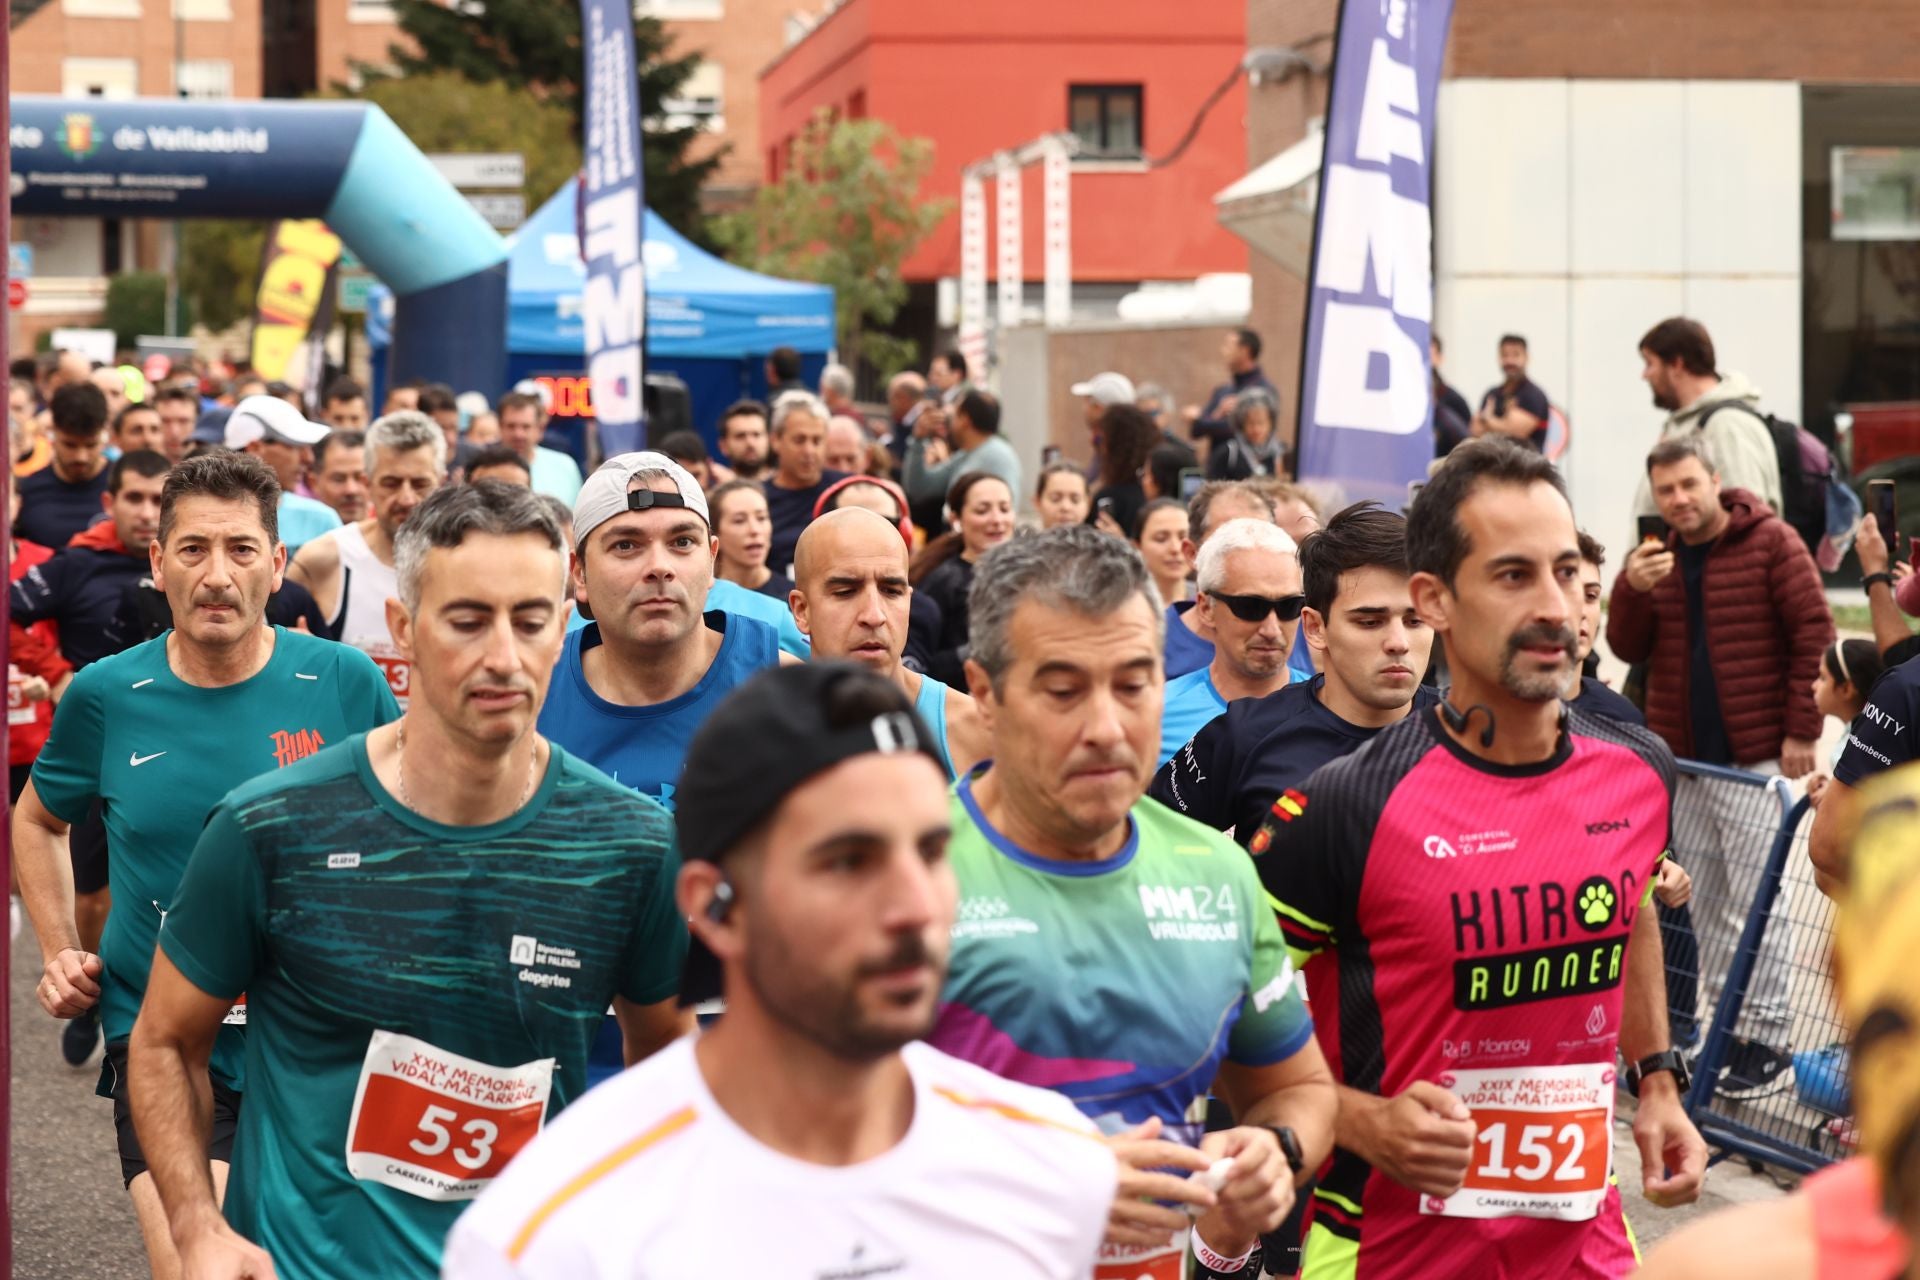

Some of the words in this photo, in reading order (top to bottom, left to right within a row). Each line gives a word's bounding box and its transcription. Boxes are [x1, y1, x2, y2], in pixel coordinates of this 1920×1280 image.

[112, 123, 147, 151] de
[147, 124, 269, 153] Valladolid
[519, 968, 572, 989] deportes
[411, 1052, 448, 1074] XXIX
[1479, 1079, 1514, 1092] XXIX
[1518, 1078, 1587, 1093] MEMORIAL
[1461, 1089, 1600, 1106] VIDAL-MATARRANZ
[408, 1104, 499, 1170] 53
[1477, 1122, 1586, 1182] 152
[386, 1164, 435, 1187] CARRERA
[1476, 1196, 1525, 1209] CARRERA
[1528, 1199, 1573, 1210] POPULAR
